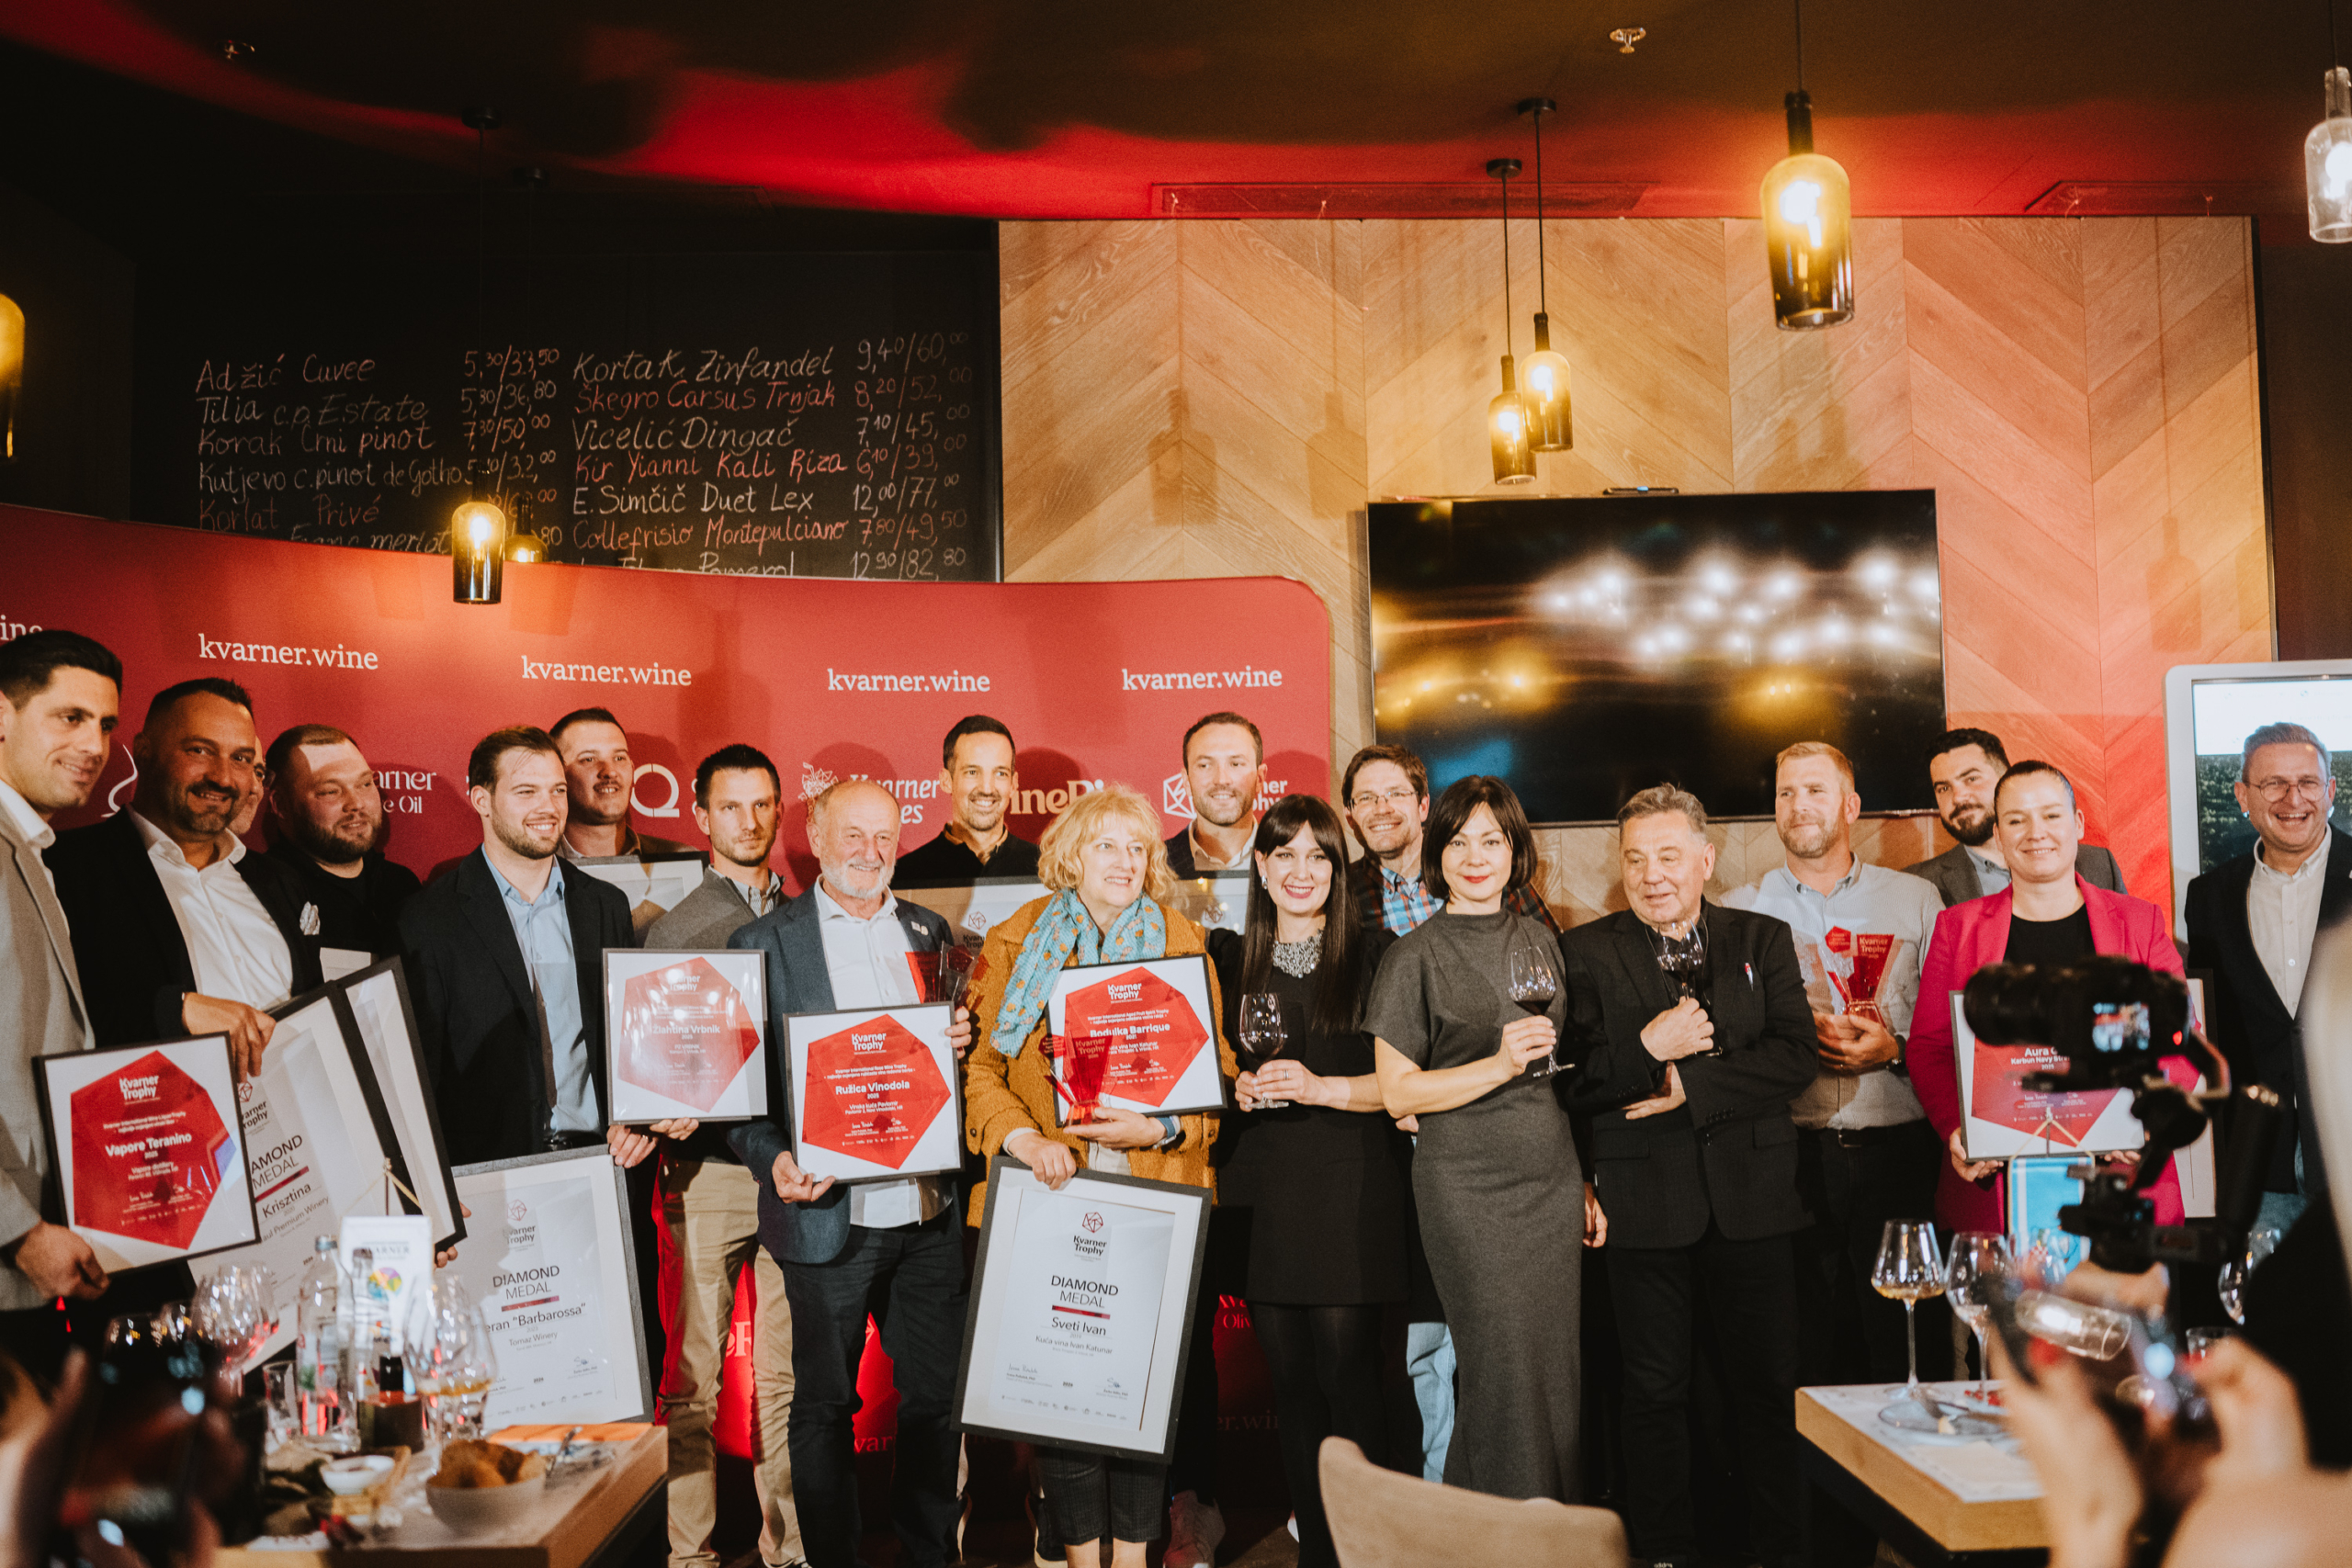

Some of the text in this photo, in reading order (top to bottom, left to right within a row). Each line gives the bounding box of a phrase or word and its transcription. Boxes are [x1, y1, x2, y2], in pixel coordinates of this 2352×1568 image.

[195, 353, 285, 393] Adžić
[695, 346, 832, 385] Zinfandel
[196, 395, 266, 424] Tilia
[574, 381, 659, 421] Škegro
[767, 379, 835, 413] Trnjak
[198, 427, 282, 456] Korak
[358, 420, 435, 458] pinot
[681, 416, 799, 457] Dingač
[717, 450, 776, 478] Kali
[199, 462, 287, 504] Kutjevo
[599, 483, 687, 514] Simčič
[700, 481, 757, 513] Duet
[771, 482, 814, 513] Lex
[199, 493, 380, 531] Korlat Privé
[198, 633, 379, 670] kvarner.wine
[521, 655, 692, 686] kvarner.wine
[828, 668, 990, 693] kvarner.wine
[1122, 666, 1283, 691] kvarner.wine
[399, 795, 423, 814] Oil
[1107, 982, 1142, 994] Kvarner
[1110, 989, 1139, 1000] Trophy
[690, 1024, 720, 1033] Vrbnik
[851, 1032, 887, 1043] Kvarner
[1128, 1022, 1170, 1034] Barrique
[854, 1041, 884, 1051] Trophy
[1075, 1038, 1106, 1047] Kvarner
[1078, 1045, 1105, 1055] Trophy
[2024, 1047, 2049, 1057] Aura
[2035, 1055, 2052, 1064] Navy
[119, 1076, 159, 1091] Kvarner
[122, 1086, 156, 1100] Trophy
[835, 1079, 910, 1095] Ružica Vinodola
[105, 1133, 192, 1157] Vapore Teranino
[252, 1134, 303, 1174] AMOND
[253, 1156, 300, 1190] MEDAL
[262, 1183, 311, 1218] Krisztina
[274, 1213, 304, 1234] Premium
[304, 1196, 329, 1214] Winery
[1073, 1235, 1107, 1248] Kvarner
[1074, 1243, 1104, 1257] Trophy
[492, 1265, 560, 1288] DIAMOND
[1050, 1274, 1119, 1296] DIAMOND
[505, 1281, 552, 1300] MEDAL
[1059, 1290, 1105, 1308] MEDAL
[484, 1319, 511, 1333] eran
[1051, 1316, 1106, 1336] Sveti Ivan
[509, 1337, 532, 1348] Tomaz
[532, 1332, 558, 1343] Winery
[1035, 1335, 1053, 1345] Kuća
[1054, 1339, 1069, 1348] vina
[1069, 1341, 1084, 1350] Ivan
[1085, 1343, 1113, 1355] Katunar
